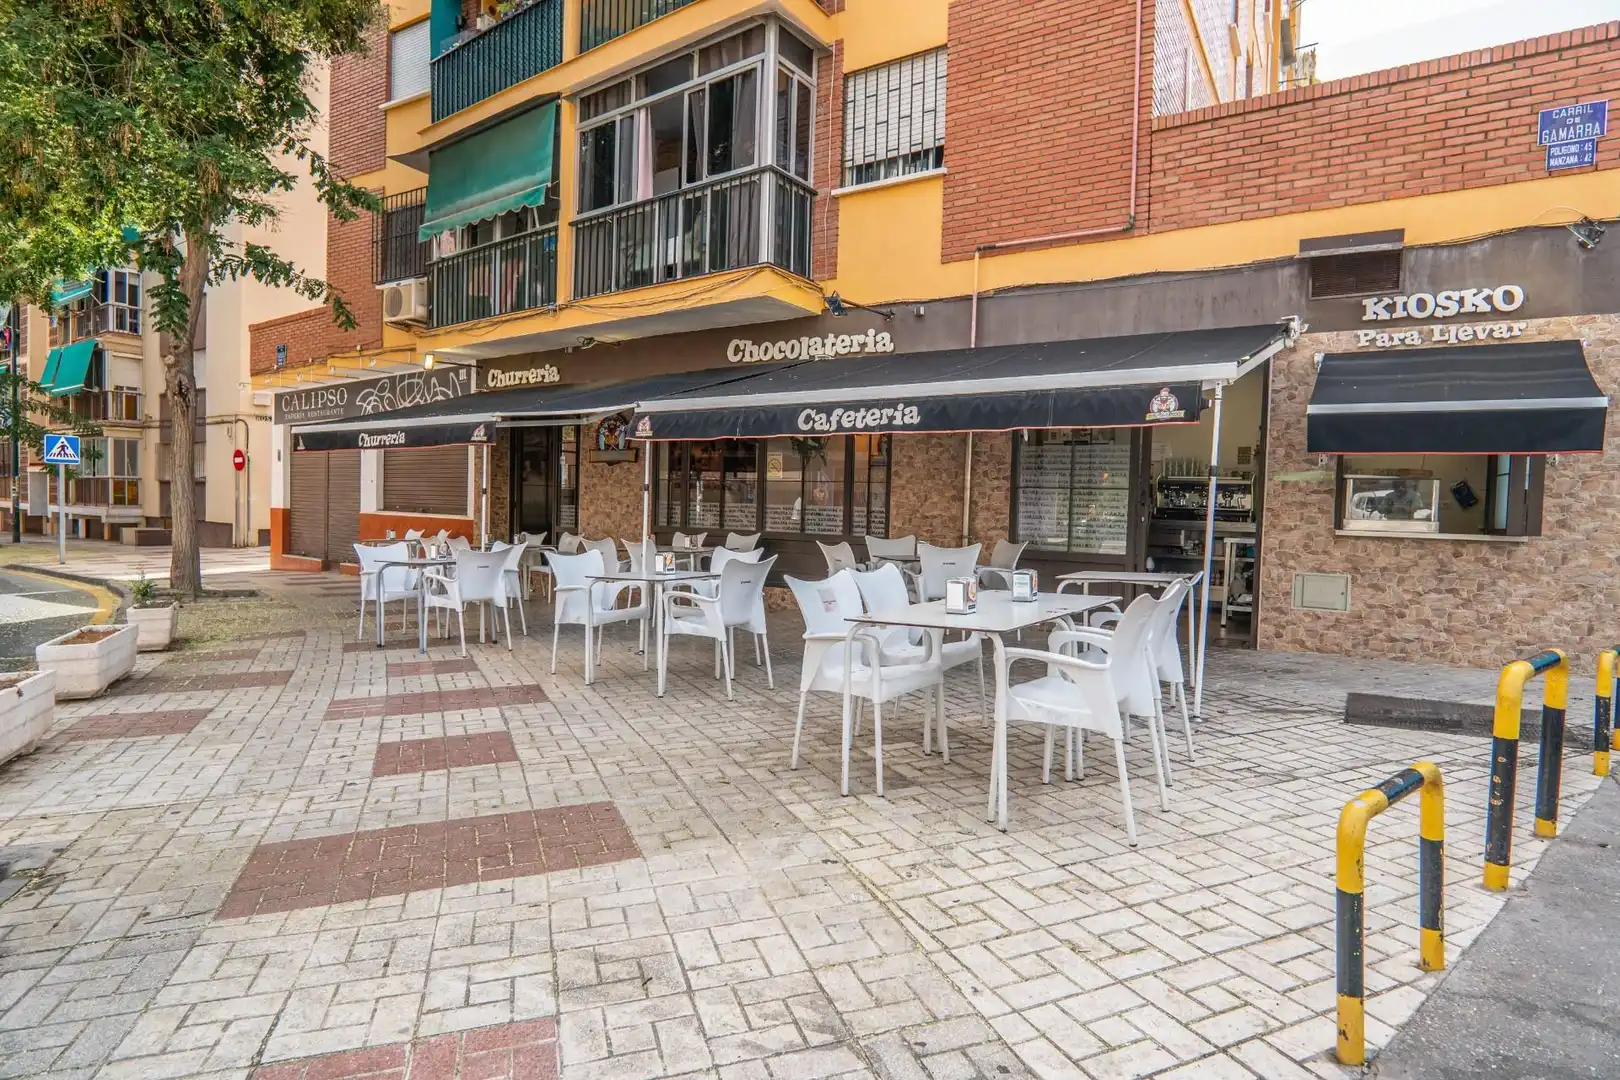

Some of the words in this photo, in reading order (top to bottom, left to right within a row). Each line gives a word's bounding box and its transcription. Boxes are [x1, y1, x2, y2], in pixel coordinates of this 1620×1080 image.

[1552, 105, 1594, 119] CARRIL
[1566, 117, 1581, 125] DE
[1542, 122, 1601, 144] GAMARRA
[1584, 141, 1593, 152] 45
[1549, 154, 1579, 167] MANZANA
[1584, 153, 1593, 162] 42
[1362, 285, 1525, 321] KIOSKO
[726, 328, 895, 363] Chocolateria
[1356, 329, 1422, 348] Para
[1431, 321, 1527, 344] Llevar
[488, 363, 561, 387] Churreria
[282, 387, 348, 412] CALIPSO
[797, 403, 921, 432] Cafeteria
